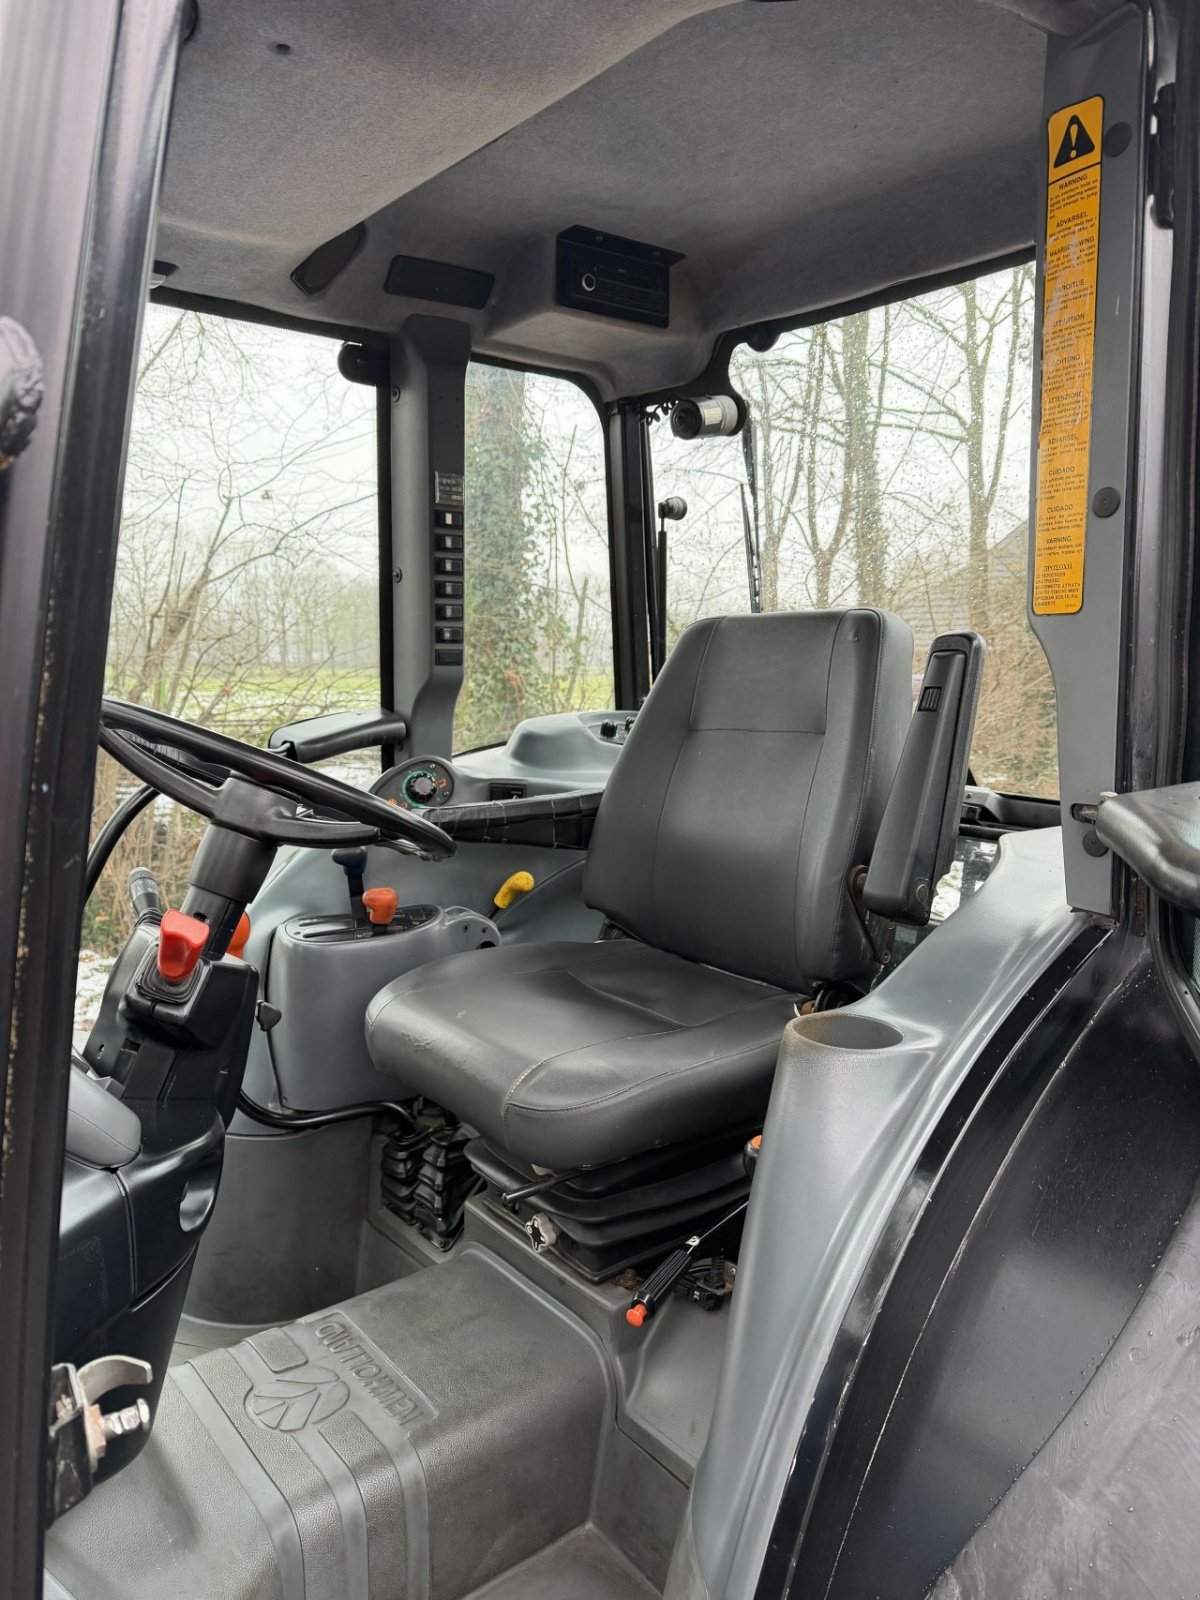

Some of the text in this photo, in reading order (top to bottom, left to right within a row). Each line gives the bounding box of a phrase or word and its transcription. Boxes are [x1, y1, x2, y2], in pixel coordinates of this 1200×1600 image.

[1058, 174, 1088, 190] WARNING
[1056, 211, 1088, 228] ADVARSEL
[1049, 235, 1095, 257] WAARSCWING
[1056, 279, 1085, 292] ROITUS
[1053, 353, 1081, 367] CHTUNG
[1048, 466, 1075, 476] CUIDADO
[1046, 503, 1073, 513] CUIDADO
[1046, 536, 1072, 544] VARNING
